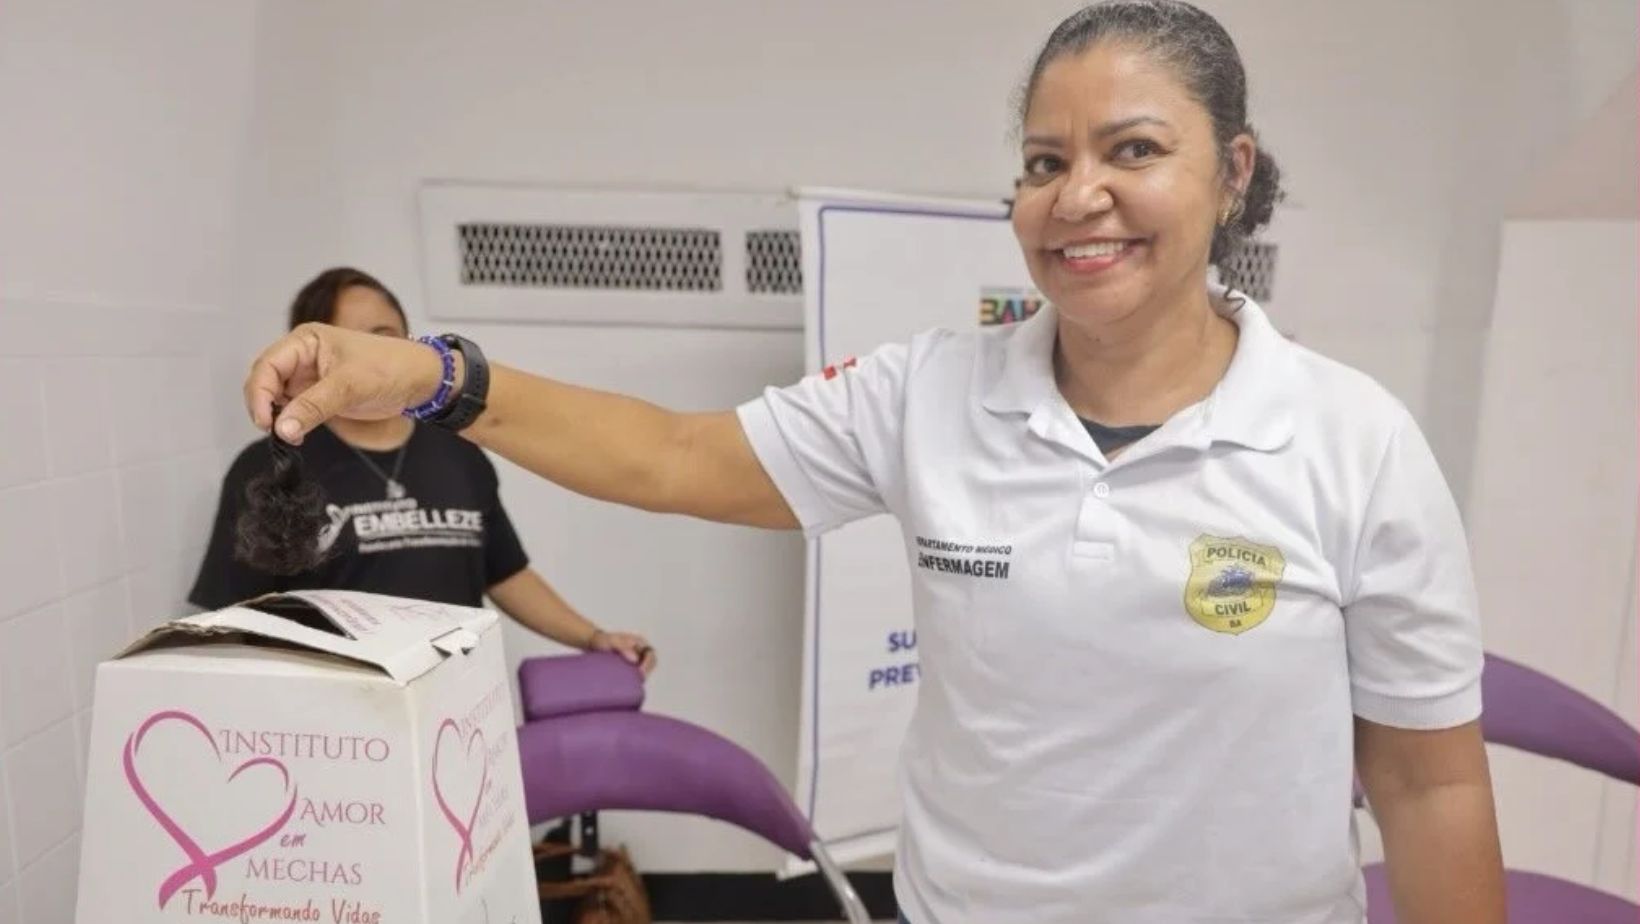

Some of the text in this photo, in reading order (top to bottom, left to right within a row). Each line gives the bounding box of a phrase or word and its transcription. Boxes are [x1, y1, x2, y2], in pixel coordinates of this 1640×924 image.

[353, 509, 483, 538] EMBELLEZE
[1215, 601, 1252, 616] CIVIL
[888, 630, 917, 653] SU
[220, 729, 389, 761] INSTITUTO
[300, 797, 386, 827] AMOR
[280, 833, 307, 848] em
[246, 858, 363, 885] MECHAS
[181, 888, 382, 924] Transformando Vidas
